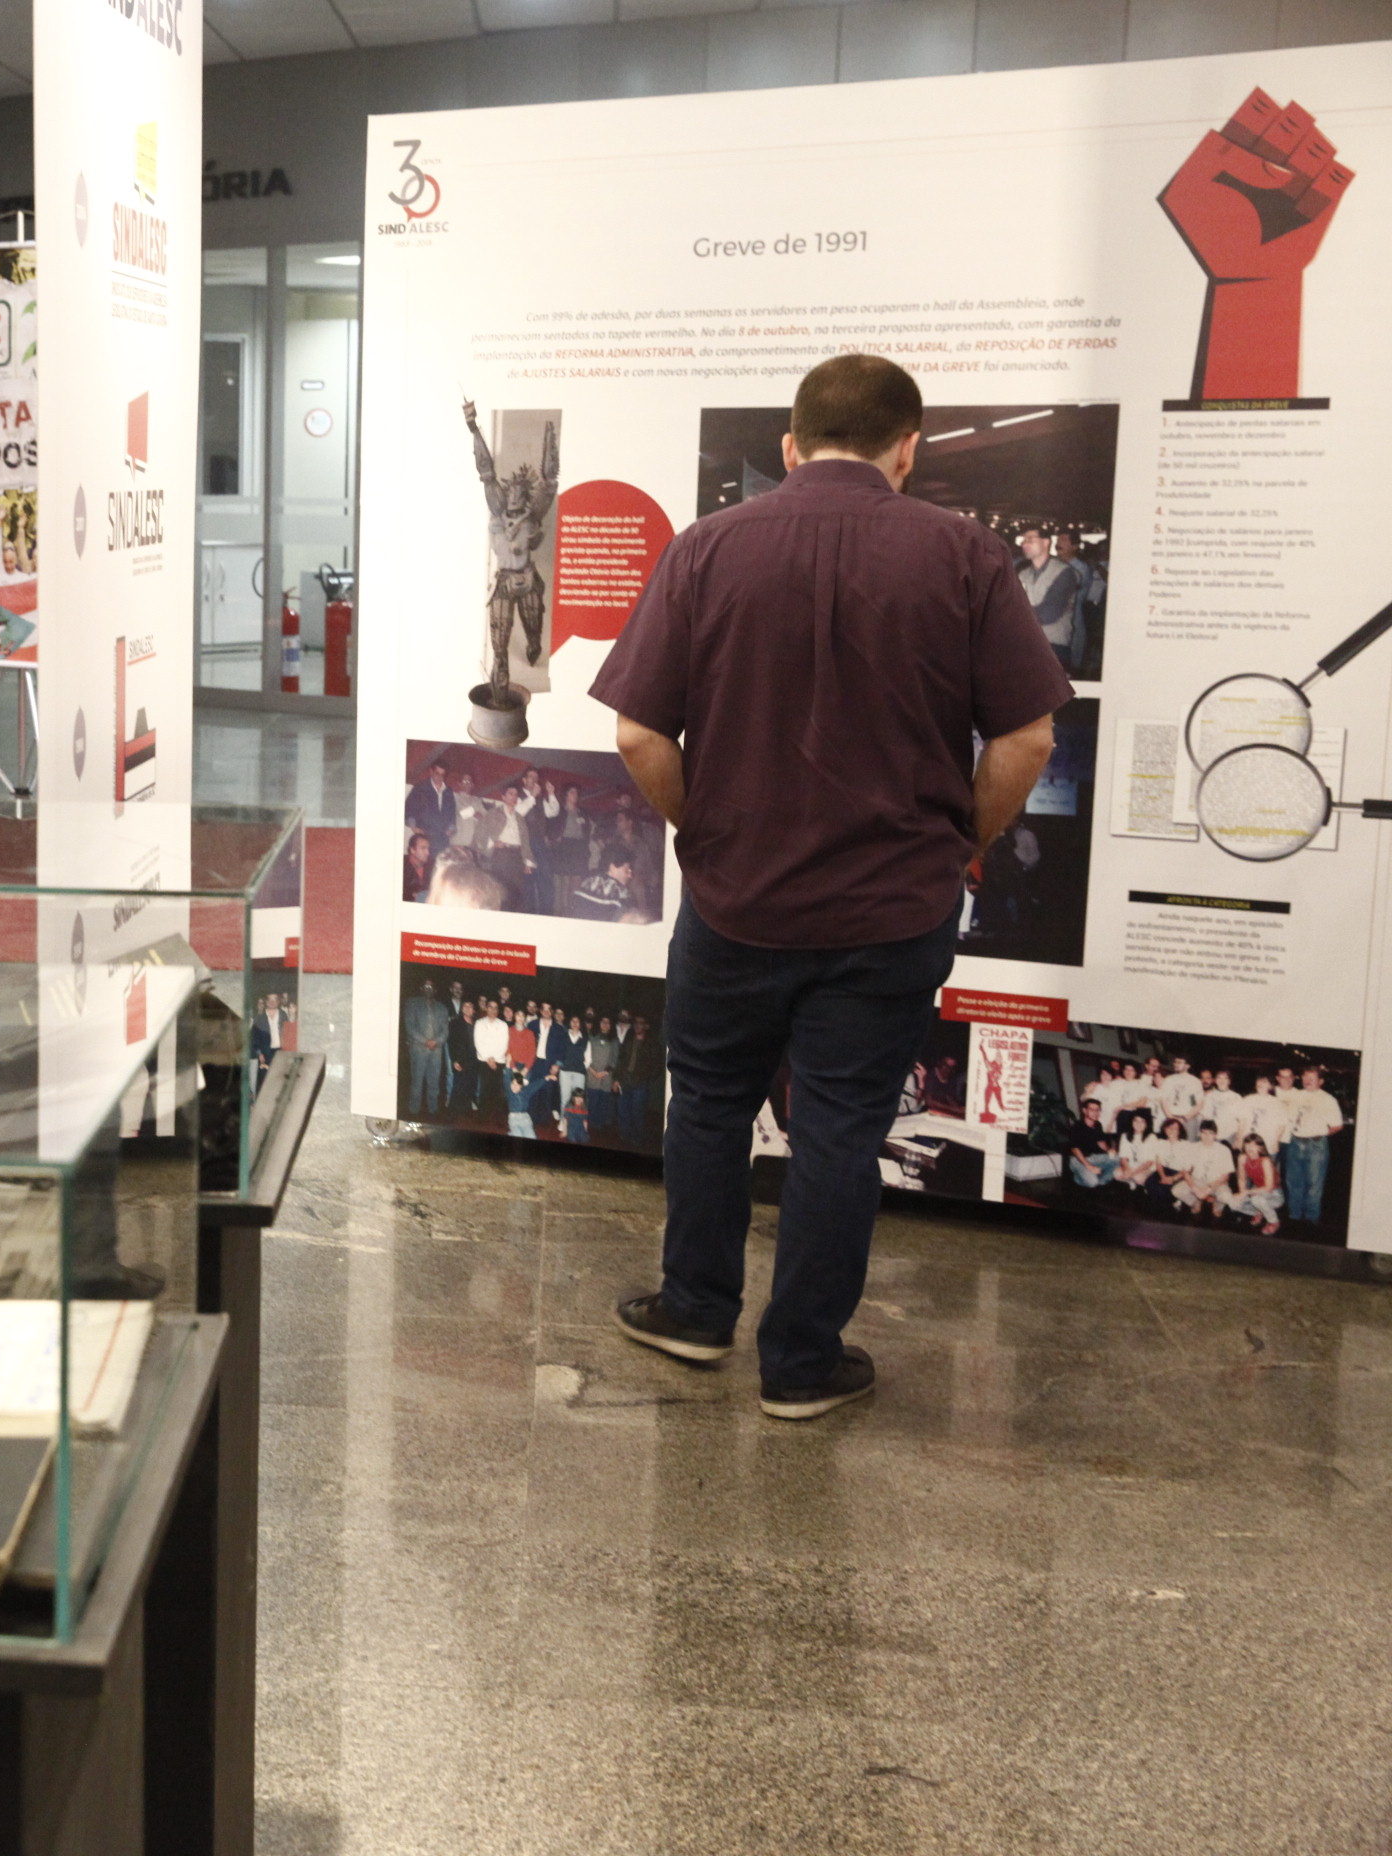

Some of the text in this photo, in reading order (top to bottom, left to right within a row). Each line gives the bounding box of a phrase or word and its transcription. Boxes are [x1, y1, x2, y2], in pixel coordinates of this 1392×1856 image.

[693, 230, 868, 258] Greve de 1991
[108, 489, 164, 552] SINDALESC
[979, 1028, 1029, 1041] CHAPA
